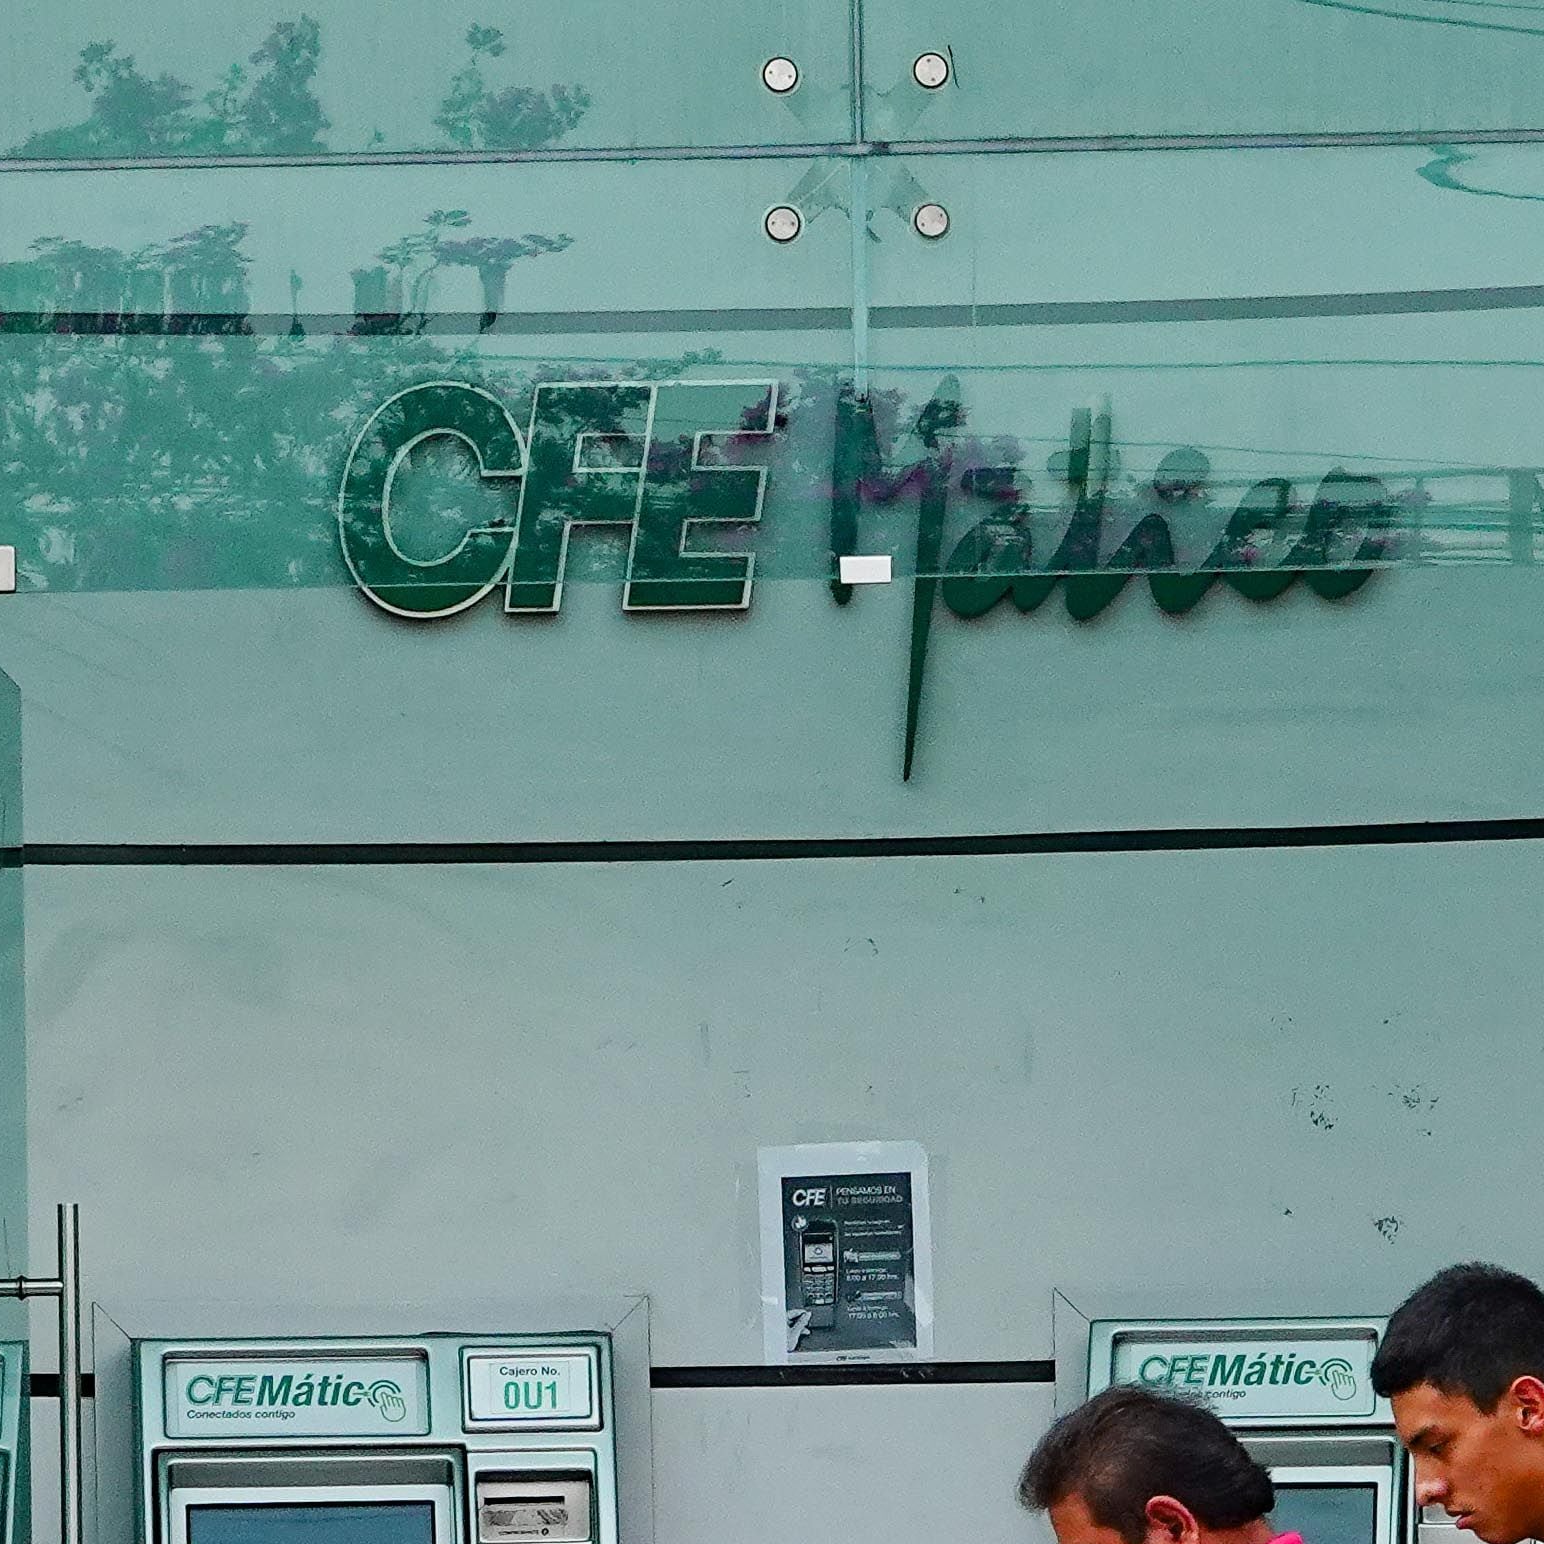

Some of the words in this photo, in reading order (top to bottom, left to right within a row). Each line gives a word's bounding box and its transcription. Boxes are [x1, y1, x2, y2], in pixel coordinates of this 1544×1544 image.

[338, 380, 779, 619] CFE
[793, 1188, 826, 1206] CFE
[499, 1366, 537, 1377] Cajero
[541, 1366, 560, 1376] No.
[1206, 1388, 1247, 1400] contigo
[187, 1409, 252, 1419] Conectados
[255, 1408, 296, 1421] contigo
